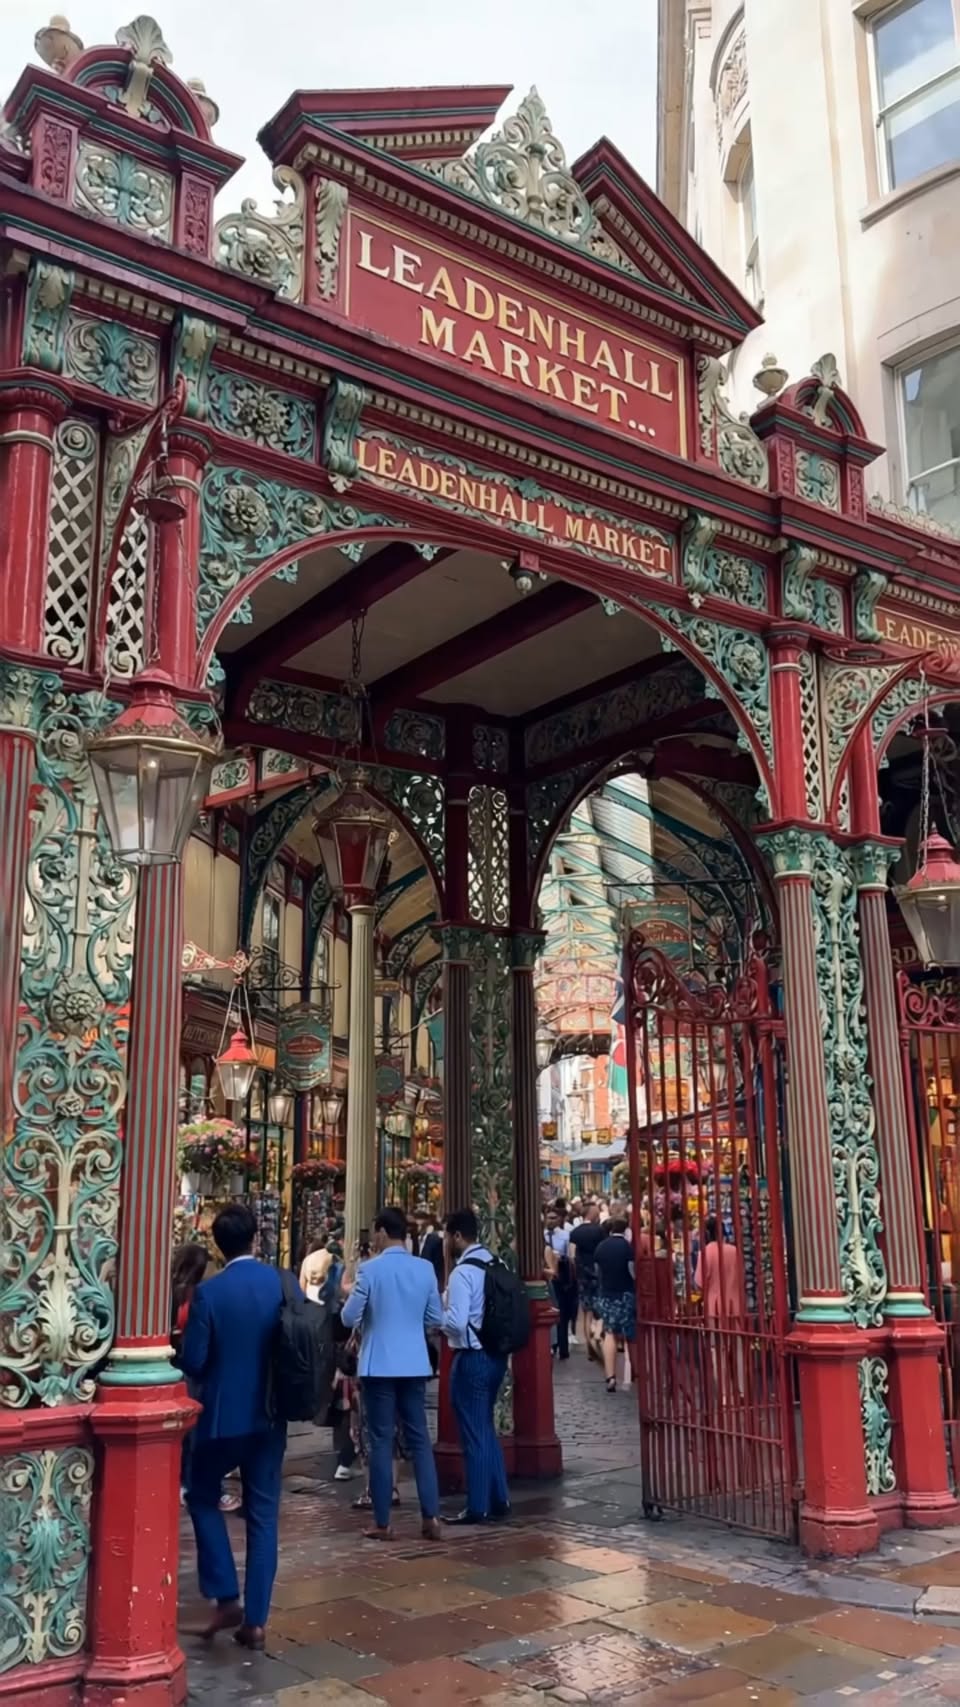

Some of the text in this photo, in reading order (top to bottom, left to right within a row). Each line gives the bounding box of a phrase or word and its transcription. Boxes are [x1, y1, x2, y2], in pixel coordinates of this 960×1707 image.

[357, 231, 673, 401] LEADENHALL
[357, 439, 670, 571] LEADENHALL MARKET
